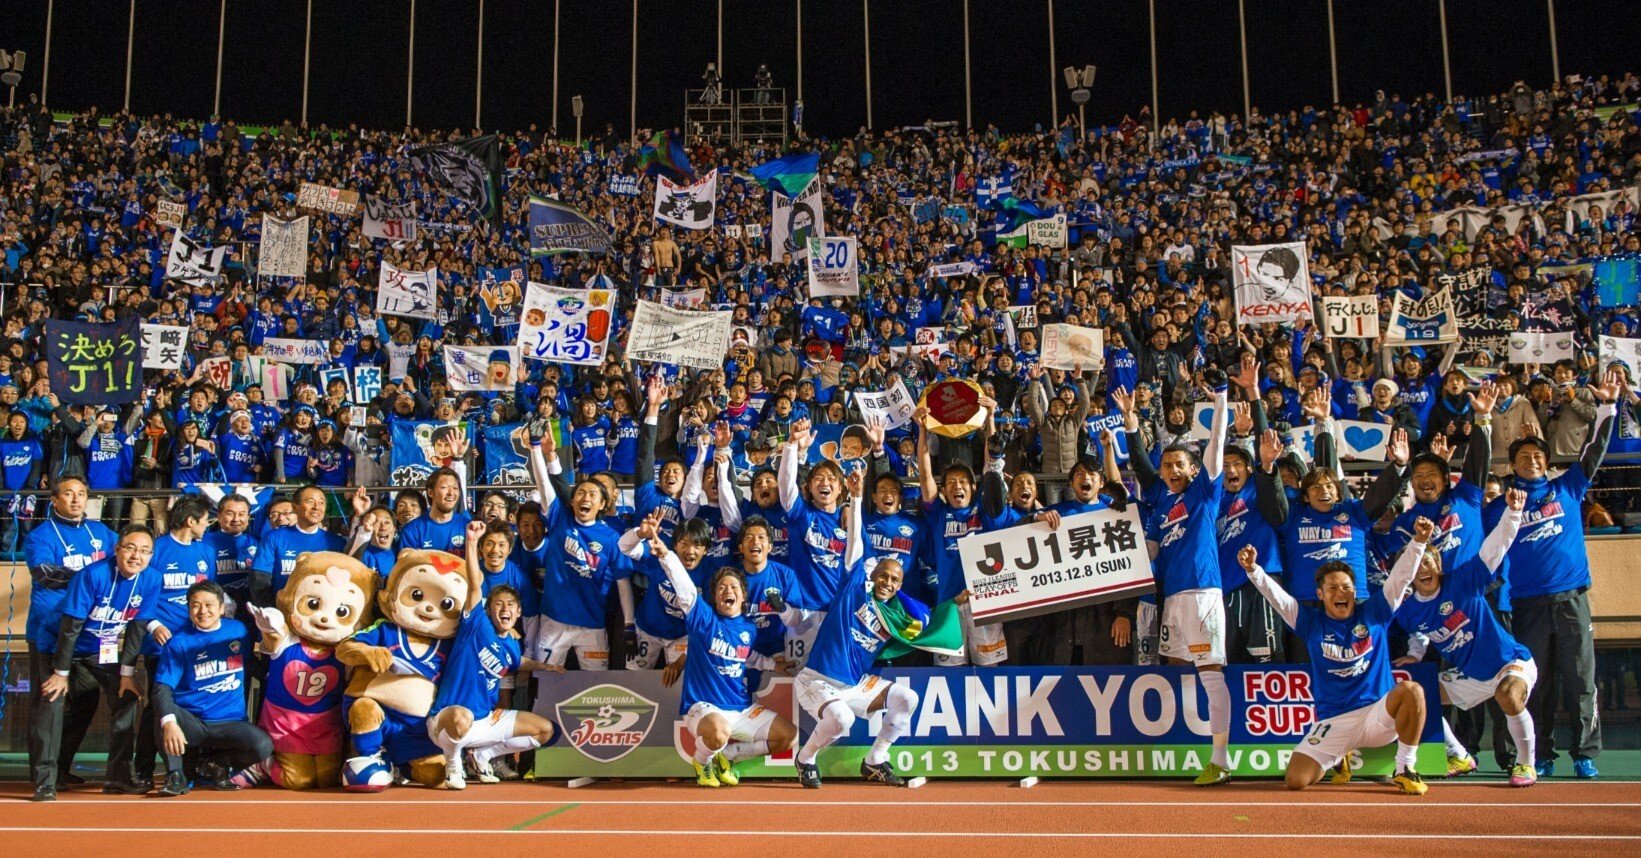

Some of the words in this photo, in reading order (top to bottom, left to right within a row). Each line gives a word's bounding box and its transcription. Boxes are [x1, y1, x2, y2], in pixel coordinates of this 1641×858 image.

[1037, 222, 1056, 230] DOU
[1037, 230, 1059, 239] GLAS
[825, 241, 848, 268] 20
[1239, 255, 1250, 278] 1
[385, 270, 408, 291] 攻
[1439, 265, 1492, 292] 守護神
[1240, 301, 1311, 317] KENYA
[1326, 302, 1377, 317] 行くんじょ
[1398, 292, 1448, 318] 화이팅!
[1331, 316, 1363, 337] J1
[1411, 329, 1436, 339] 19
[58, 332, 136, 362] 決めろ
[69, 360, 134, 393] J1!
[209, 355, 231, 391] 祝
[864, 388, 904, 409] 四国初
[882, 537, 892, 548] to
[1298, 526, 1320, 540] WAY
[1321, 529, 1332, 539] to
[1014, 518, 1138, 571] J1昇格
[163, 572, 187, 587] WAY
[1030, 562, 1093, 588] 2013.12.8
[1095, 556, 1132, 577] (SUN)
[974, 587, 1020, 601] FINAL
[478, 646, 496, 670] WAY
[544, 648, 553, 664] 7
[788, 639, 805, 658] 13
[194, 659, 218, 677] WAY
[296, 670, 328, 697] 12
[1245, 672, 1311, 701] FOR
[581, 695, 635, 706] TOKUSHIMA
[840, 675, 1065, 737] HANK
[1248, 706, 1317, 734] SUP
[571, 718, 644, 748] VORTIS
[977, 750, 1204, 771] TOKUSHIMA
